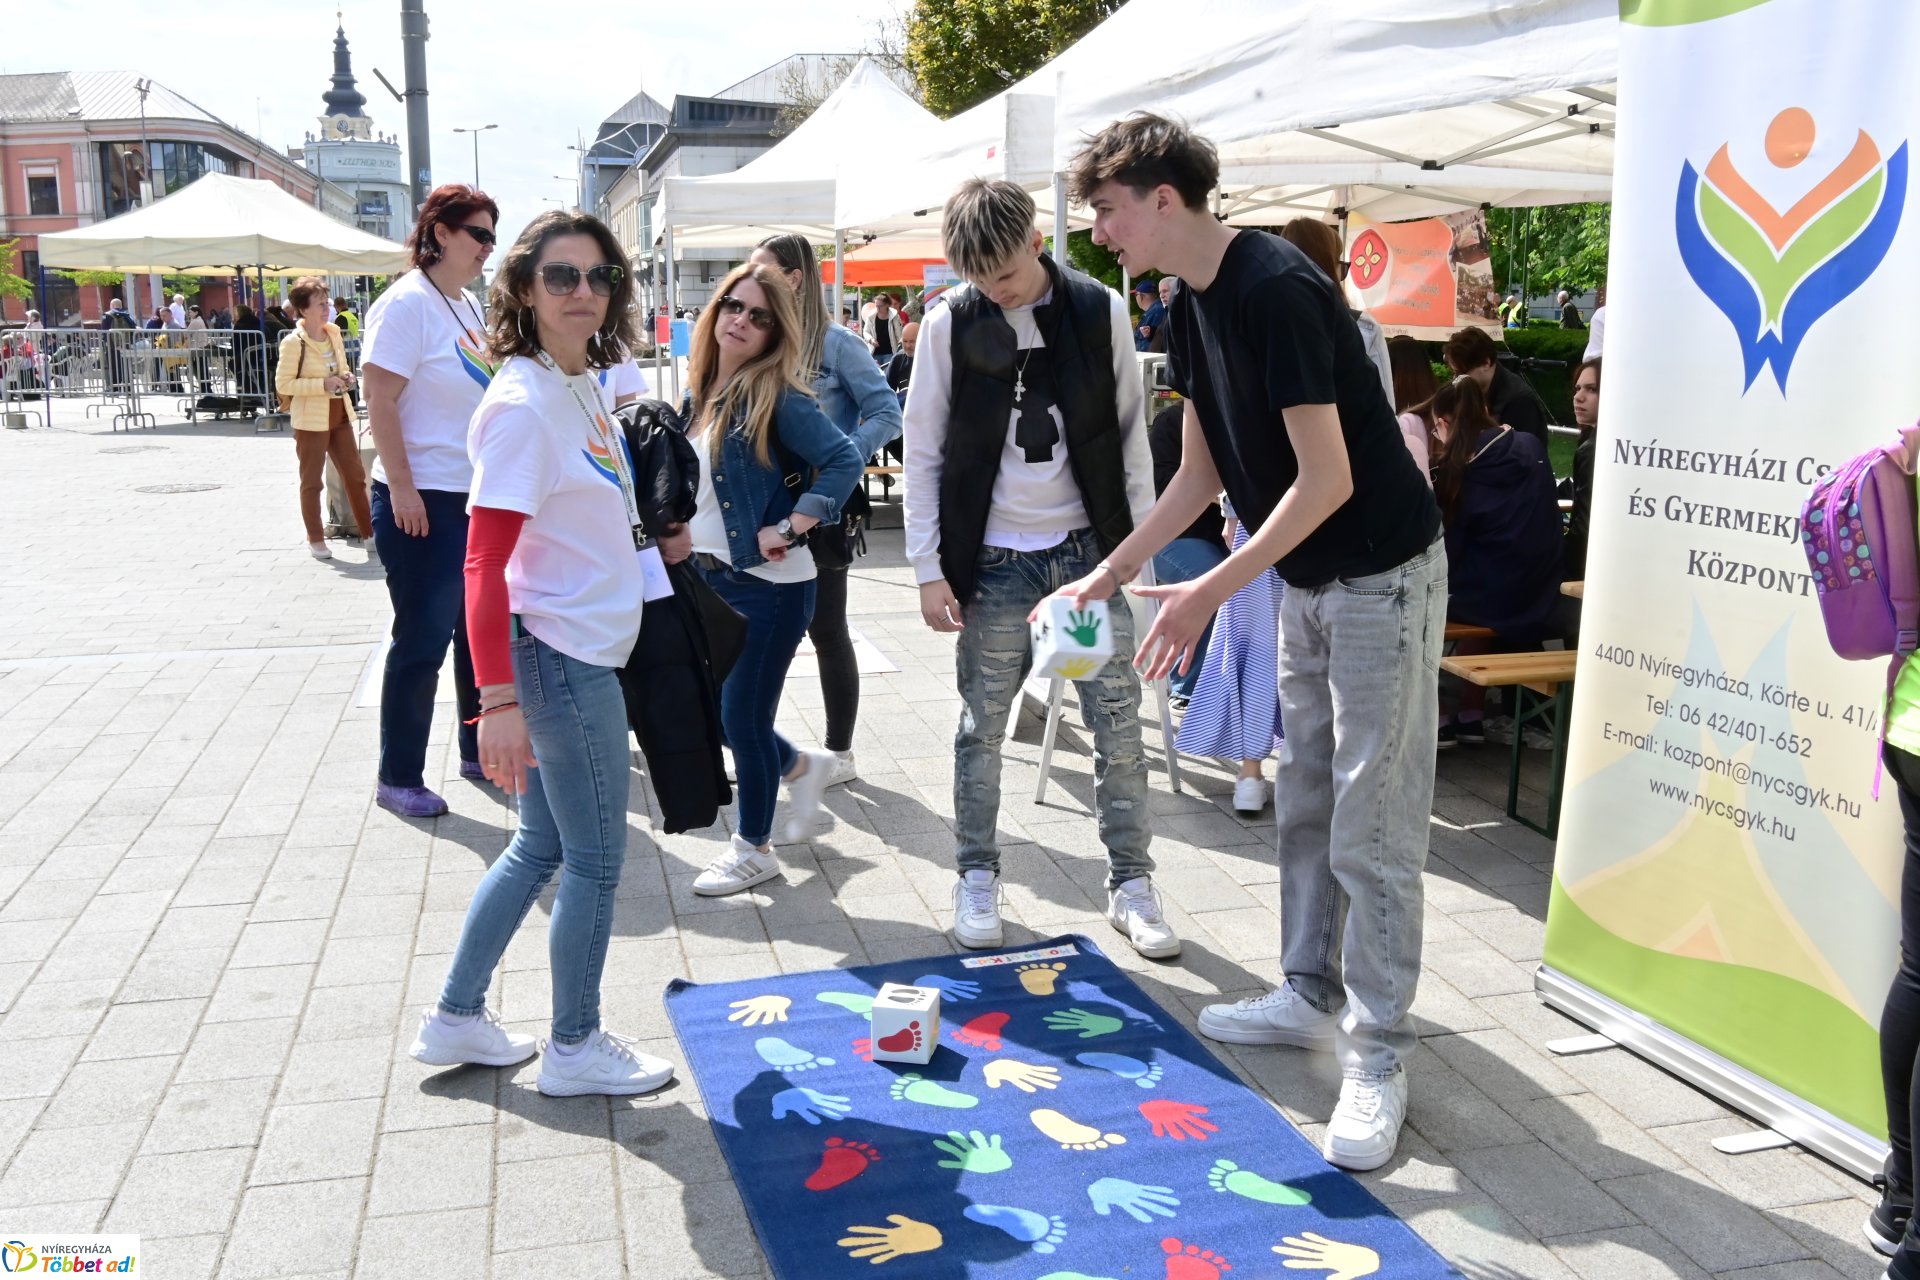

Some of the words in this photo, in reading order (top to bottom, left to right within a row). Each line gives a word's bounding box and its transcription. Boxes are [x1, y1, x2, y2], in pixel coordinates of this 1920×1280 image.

[1665, 494, 1803, 545] GYERMEKJ
[1595, 643, 1635, 668] 4400
[1640, 652, 1753, 701] Nyíregyháza,
[1761, 682, 1811, 713] Körte
[1817, 700, 1834, 720] u.
[1647, 694, 1674, 719] Tel:
[1680, 703, 1701, 726] 06
[1707, 711, 1813, 759] 42/401-652
[1604, 721, 1658, 754] E-mail:
[1664, 739, 1861, 820] kozpont@nycsgyk.hu
[1650, 778, 1796, 842] www.nycsgyk.hu
